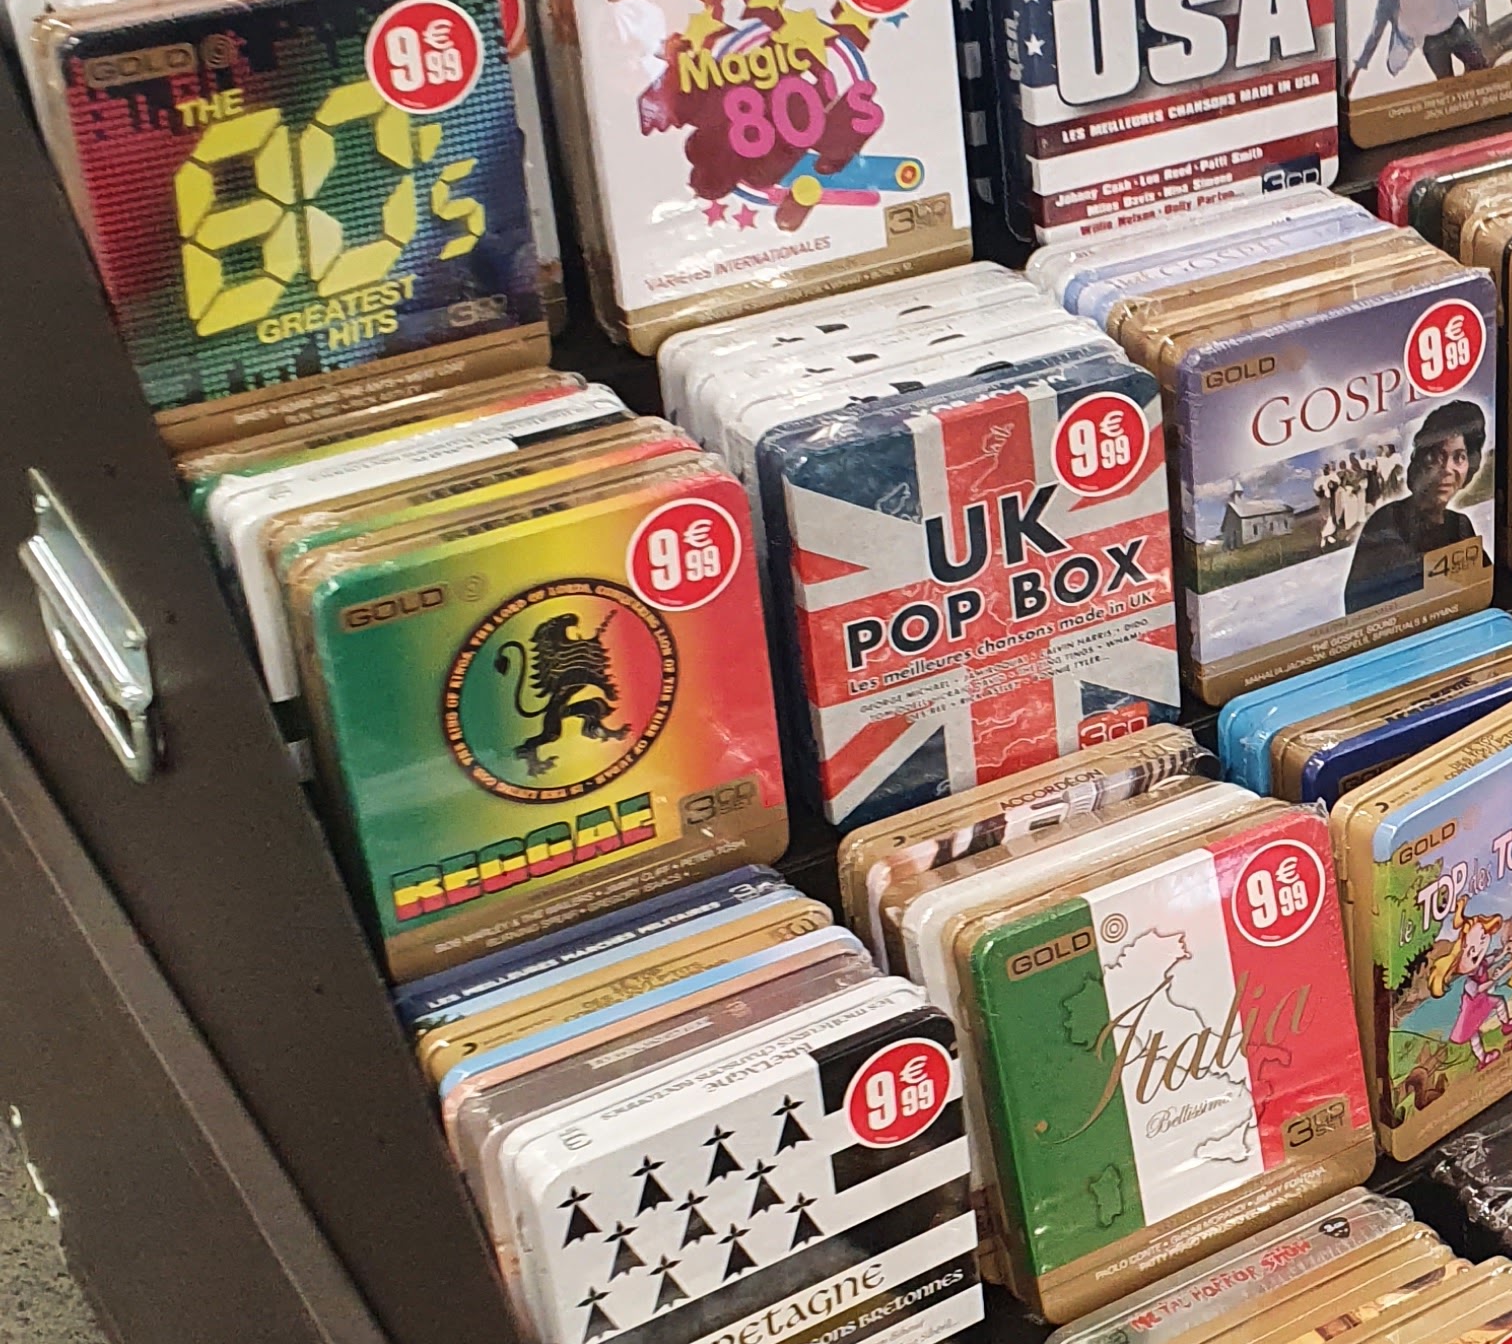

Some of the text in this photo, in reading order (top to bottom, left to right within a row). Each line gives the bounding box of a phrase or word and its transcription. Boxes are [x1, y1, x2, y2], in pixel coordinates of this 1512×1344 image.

[91, 50, 192, 84] GOLD
[677, 36, 812, 95] Magic
[175, 88, 245, 128] THE
[1061, 72, 1320, 144] LES MEILLEURES CHANSONS MADE IN USA
[1055, 185, 1098, 209] Johnny
[256, 276, 417, 344] GREATEST
[328, 313, 400, 351] HITS
[1204, 356, 1276, 389] GOLD
[924, 483, 1070, 586] UK
[345, 586, 447, 630] GOLD
[846, 538, 1151, 673] POP BOX
[848, 590, 1156, 695] Les meilleures chansons made in UK
[390, 791, 659, 923] REGGAE
[1398, 822, 1456, 866] GOLD
[1416, 859, 1469, 926] TOP
[1011, 930, 1093, 977] GOLD
[1035, 971, 1315, 1145] Italia
